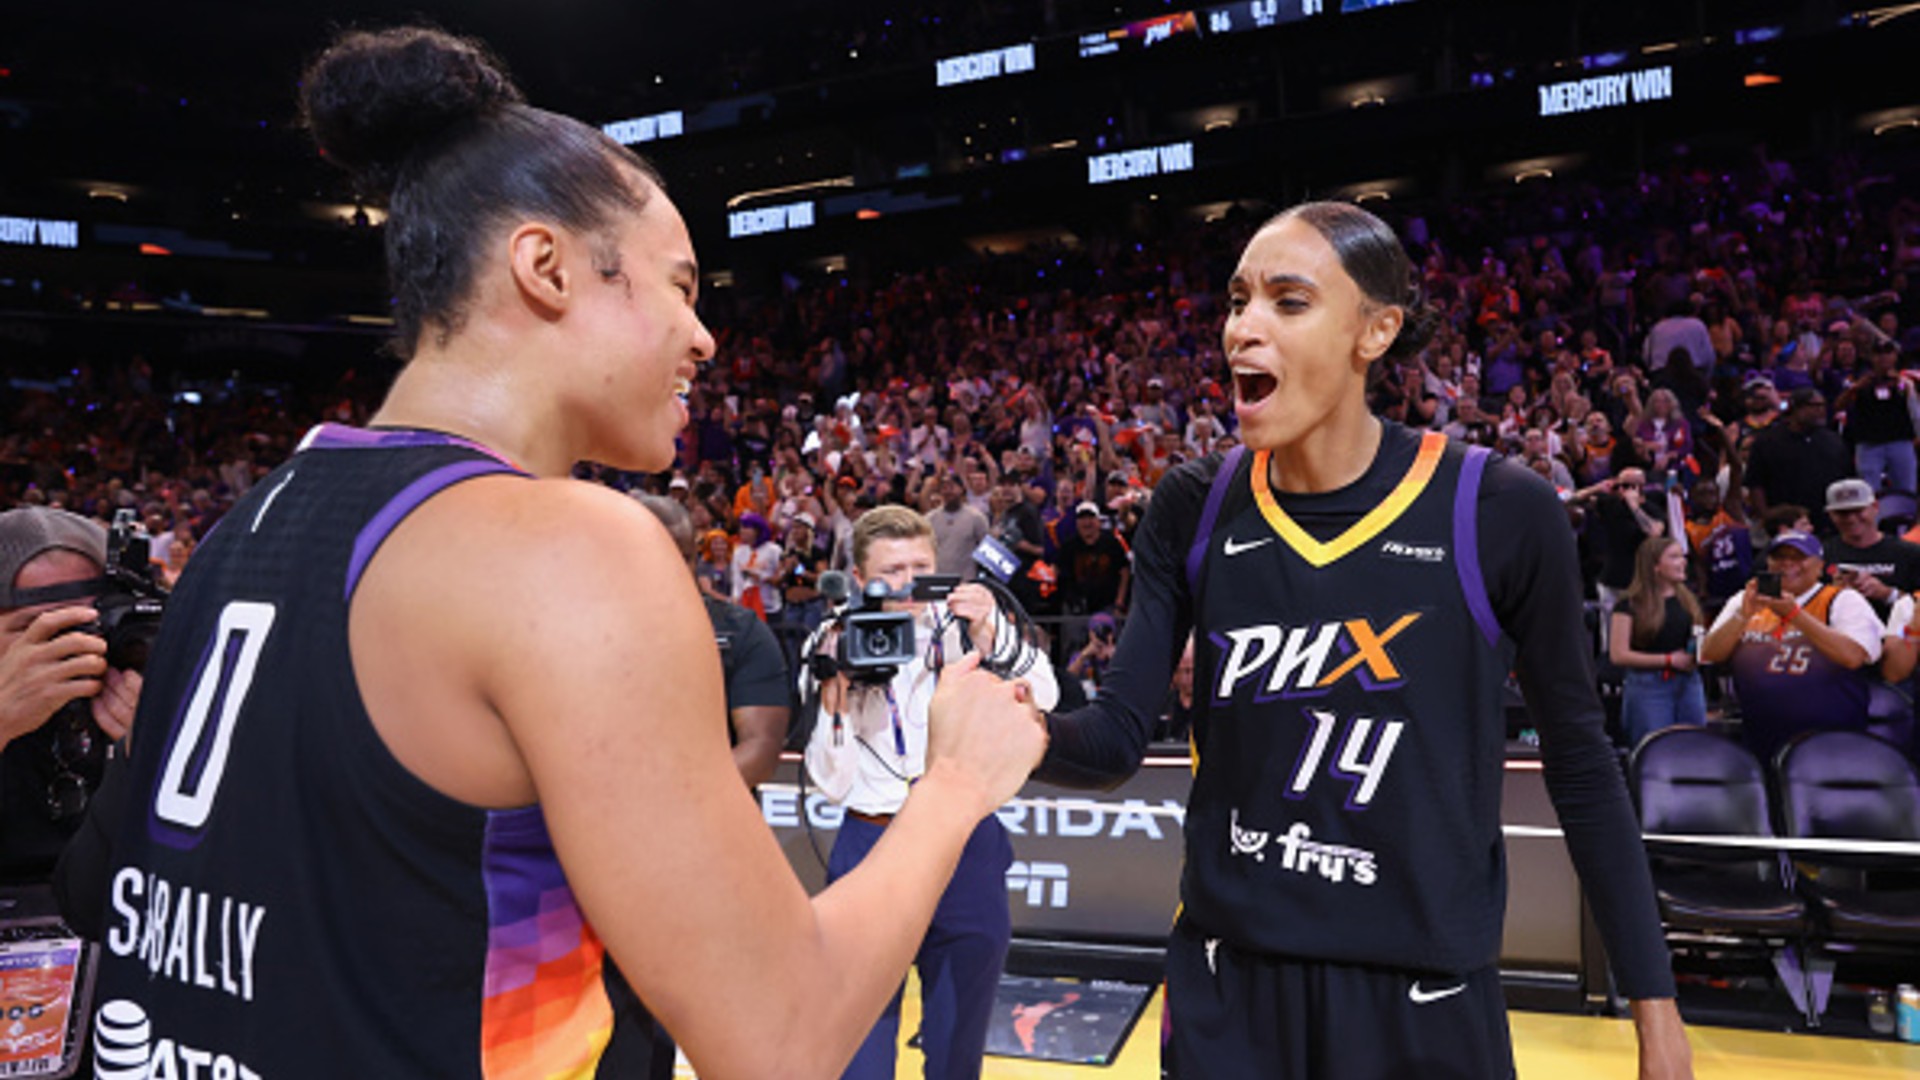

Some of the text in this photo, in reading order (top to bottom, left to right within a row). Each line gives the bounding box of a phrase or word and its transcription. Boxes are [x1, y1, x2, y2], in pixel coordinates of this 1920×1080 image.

[936, 43, 1035, 87] MERCURY WIN
[1538, 66, 1672, 116] MERCURY WIN
[1088, 141, 1193, 184] MERCURY WIN
[38, 220, 79, 248] WIN
[728, 201, 815, 238] MERCURY WIN
[1217, 611, 1424, 698] PHX
[1769, 645, 1812, 673] 25
[154, 600, 276, 829] 0
[1290, 709, 1404, 805] 14
[996, 797, 1187, 840] RIDA
[148, 1038, 263, 1080] AT
